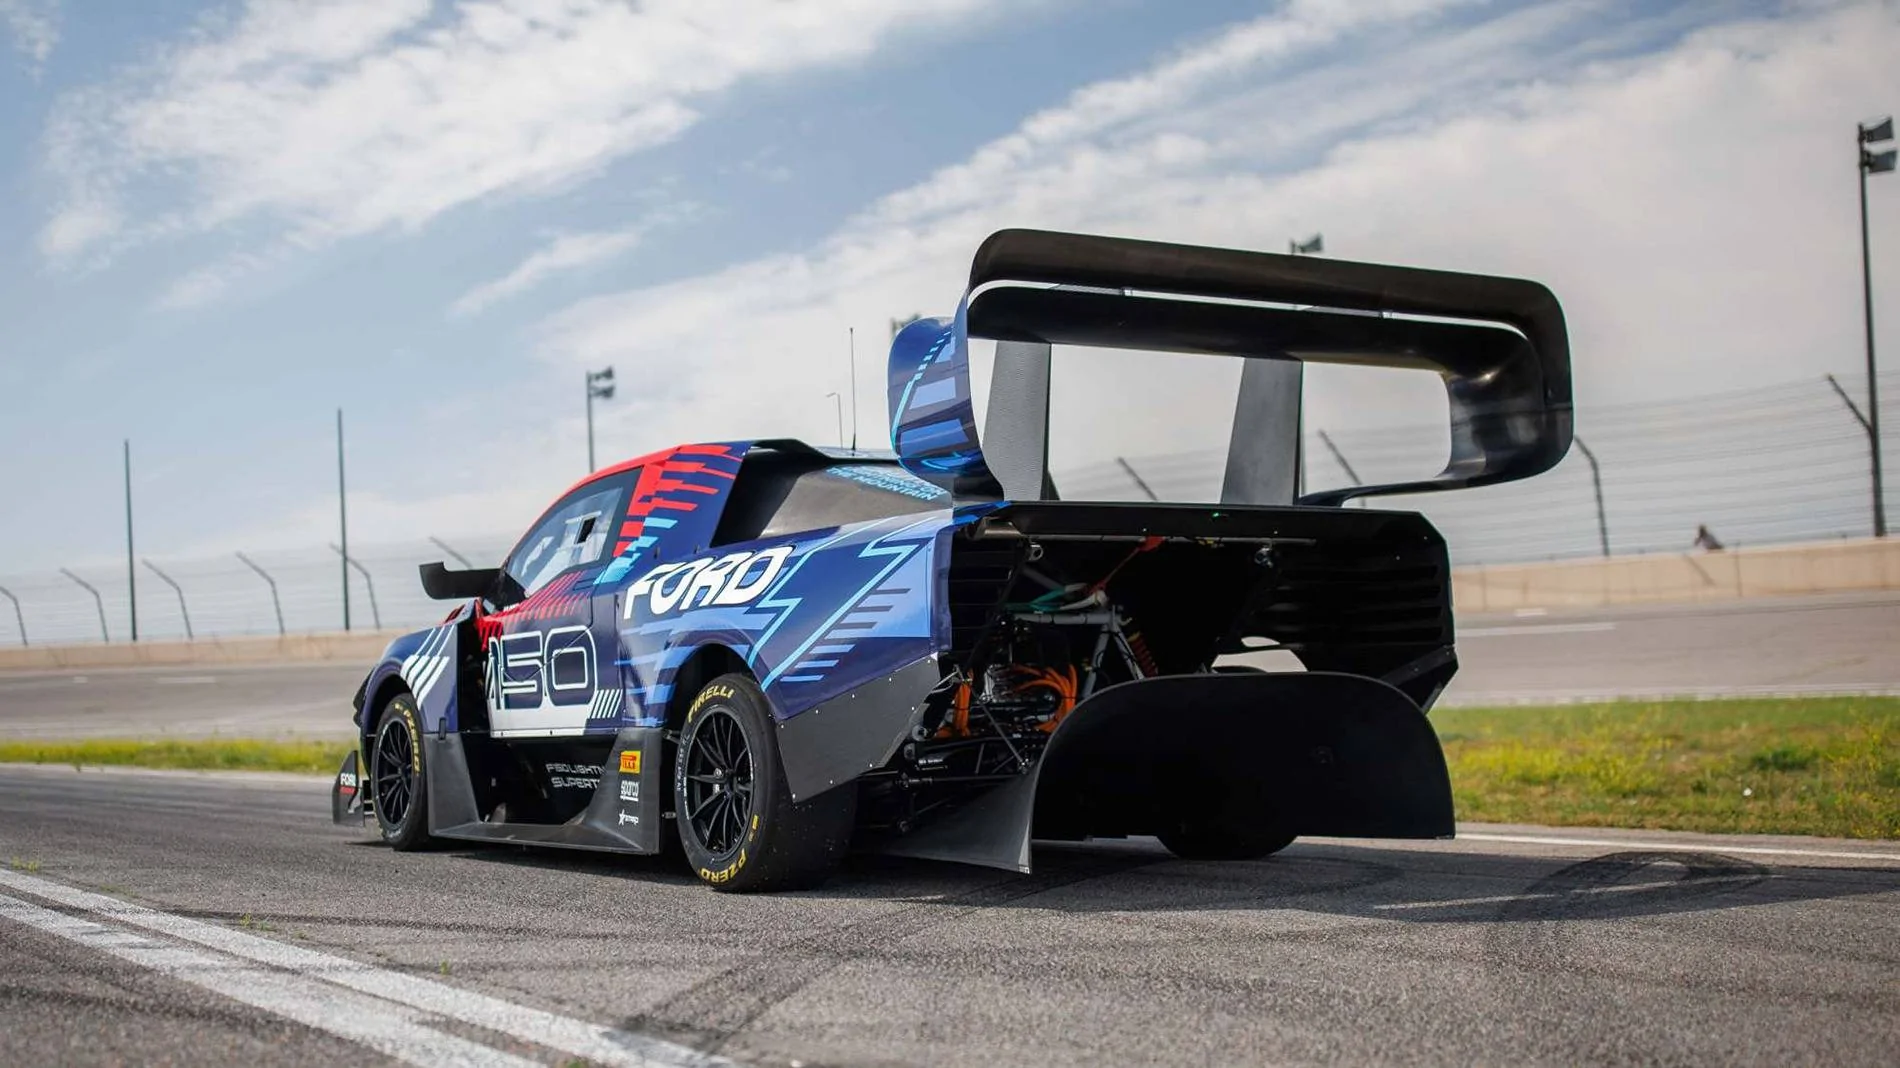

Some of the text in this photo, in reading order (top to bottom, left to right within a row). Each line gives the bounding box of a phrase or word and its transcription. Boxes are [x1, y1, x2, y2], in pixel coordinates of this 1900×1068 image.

[852, 475, 938, 501] MOUNTAIN
[623, 546, 794, 620] FORD
[551, 777, 600, 788] SUPERT
